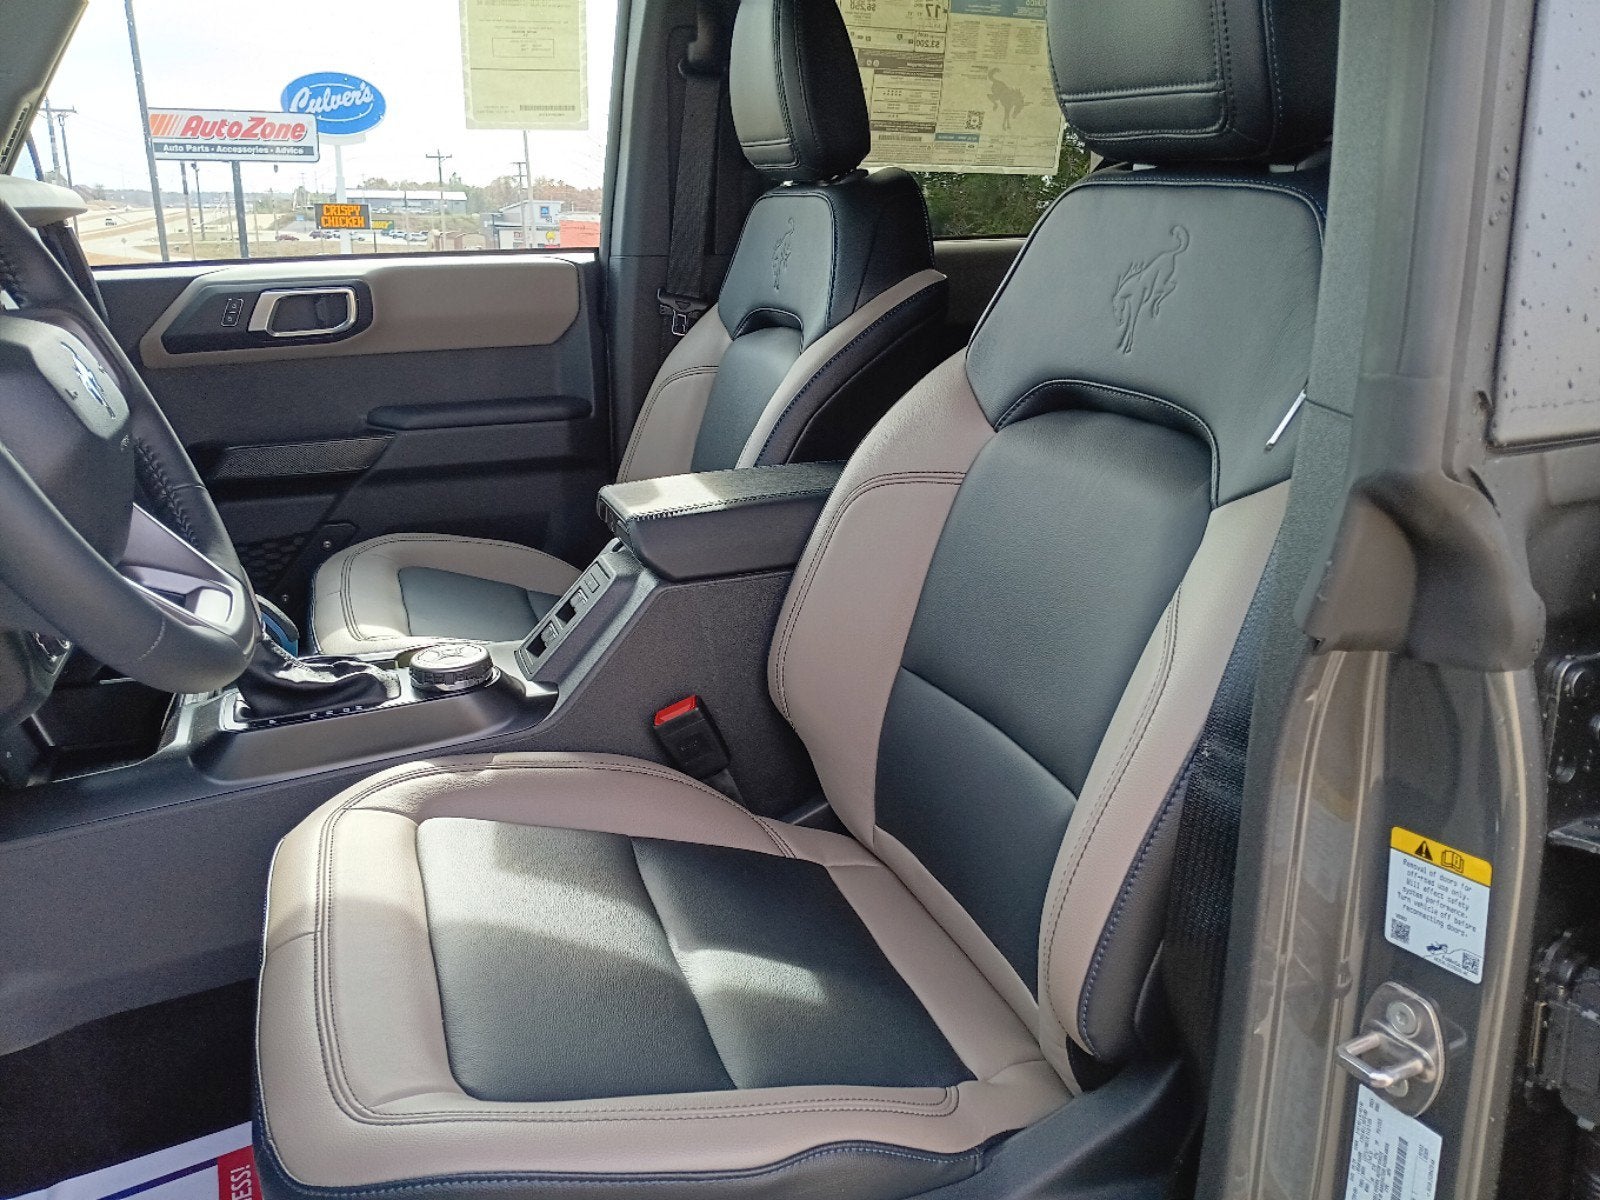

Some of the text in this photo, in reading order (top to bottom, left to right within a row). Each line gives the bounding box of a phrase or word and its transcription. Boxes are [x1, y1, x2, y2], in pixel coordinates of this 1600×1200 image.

[289, 82, 374, 113] Culver's
[181, 114, 307, 141] AutoZone
[163, 144, 304, 155] Auto Parts Accessories Advice
[321, 216, 365, 228] CHICKEN
[323, 205, 360, 216] CRISPY
[1403, 858, 1427, 874] Removal
[1440, 874, 1458, 887] doors
[1461, 882, 1472, 892] for
[1402, 886, 1423, 900] system
[1406, 878, 1420, 889] Will
[1447, 897, 1470, 912] safety
[1397, 891, 1477, 932] Turn vehicle off before
[1402, 904, 1445, 929] reconnecting
[231, 1164, 252, 1200] ESS!
